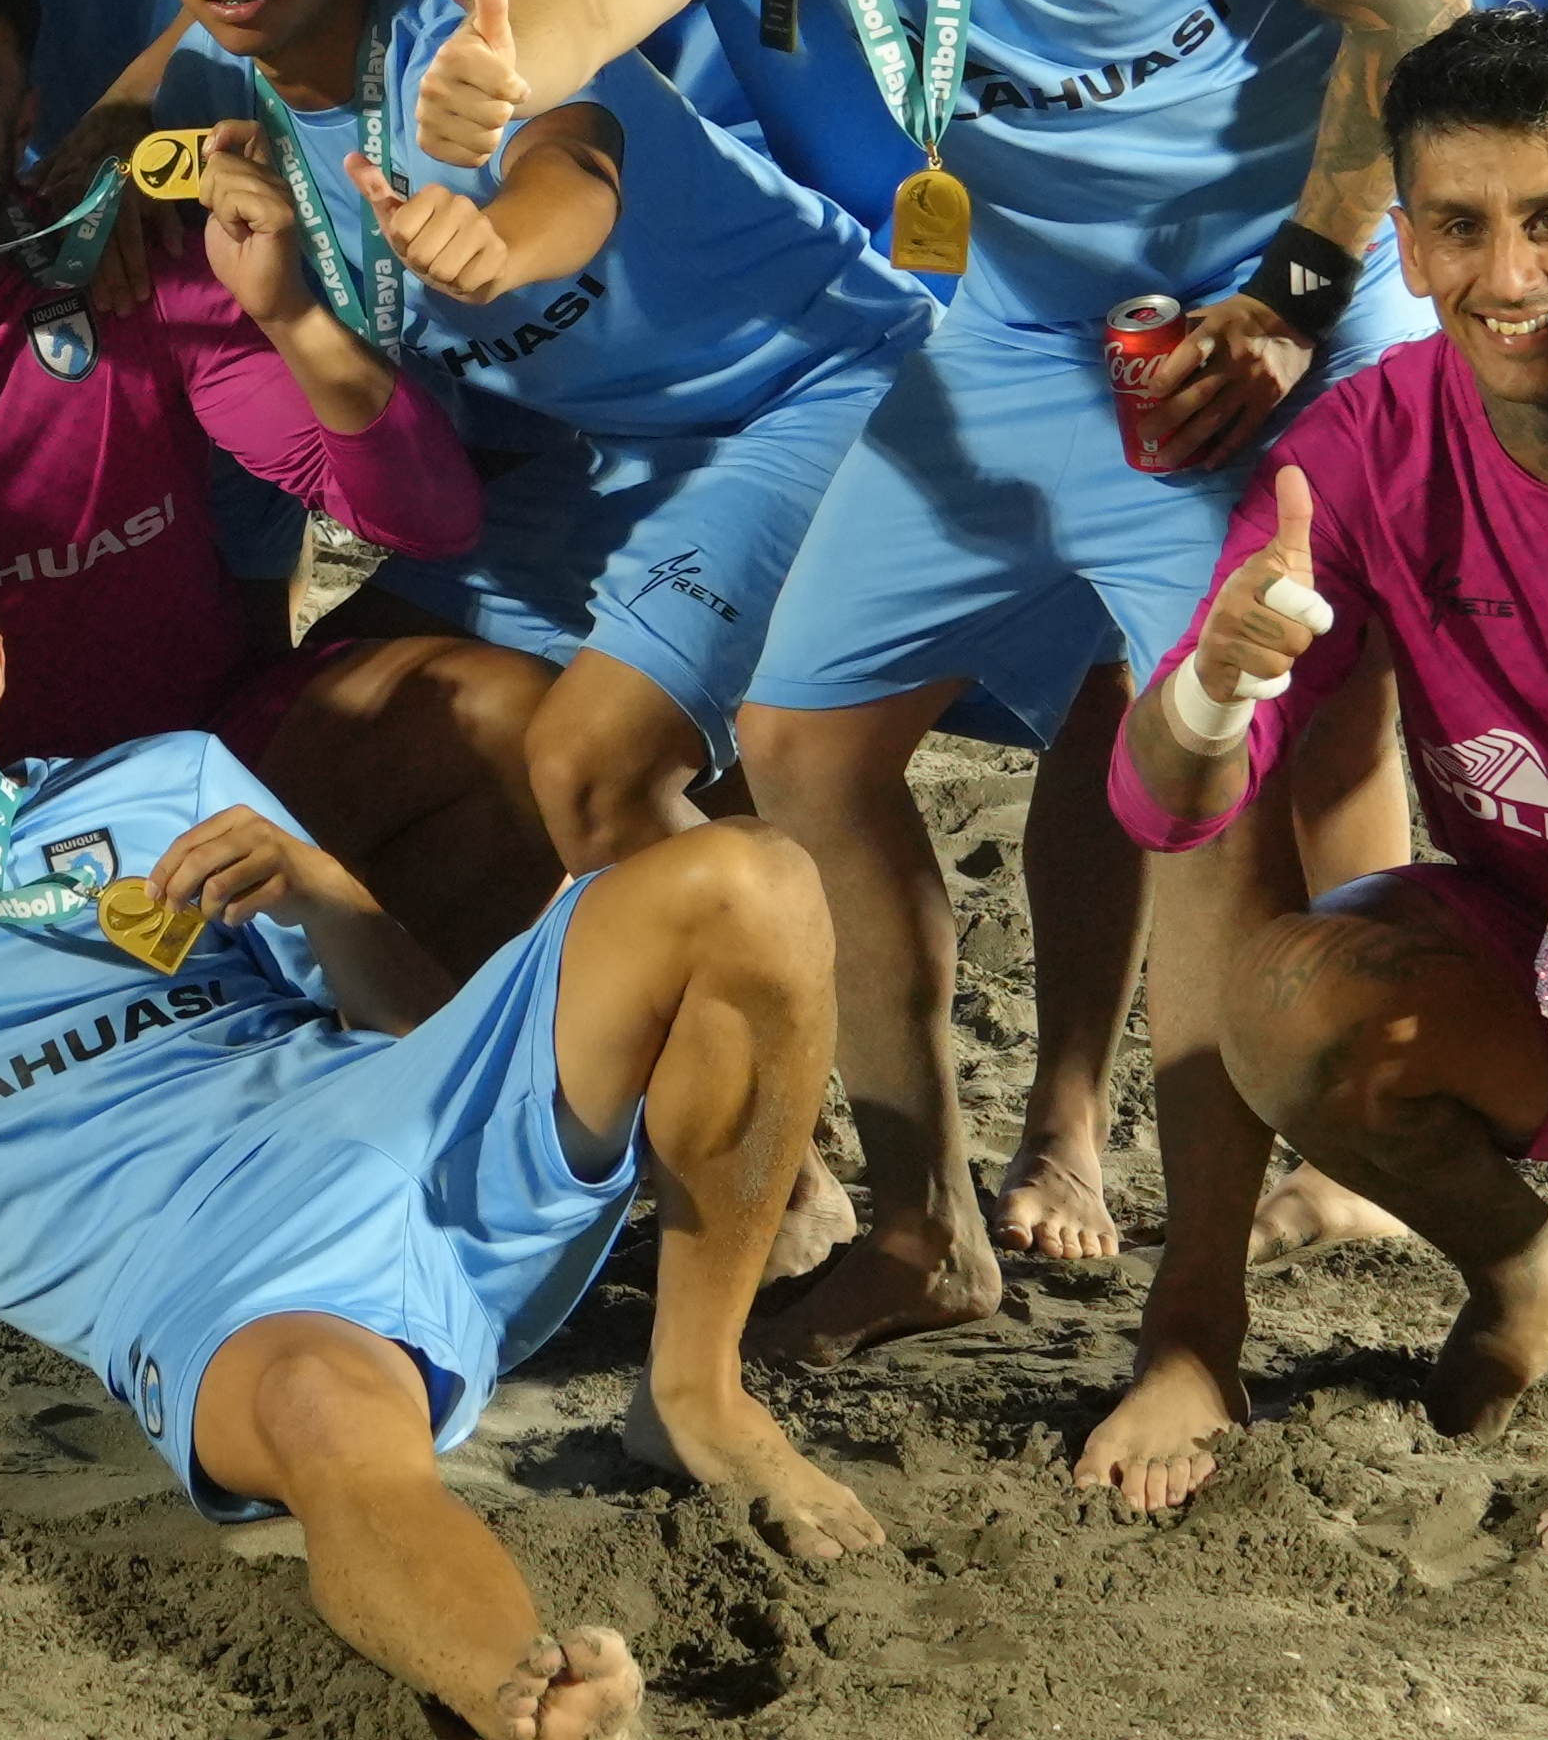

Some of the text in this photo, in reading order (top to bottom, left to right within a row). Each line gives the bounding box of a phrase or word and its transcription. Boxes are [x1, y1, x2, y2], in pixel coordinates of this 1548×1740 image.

[272, 134, 352, 309] Fútbol Playa
[31, 298, 80, 324] IQUIQUE
[373, 258, 394, 347] Playa
[49, 831, 103, 855] IQUIQUE
